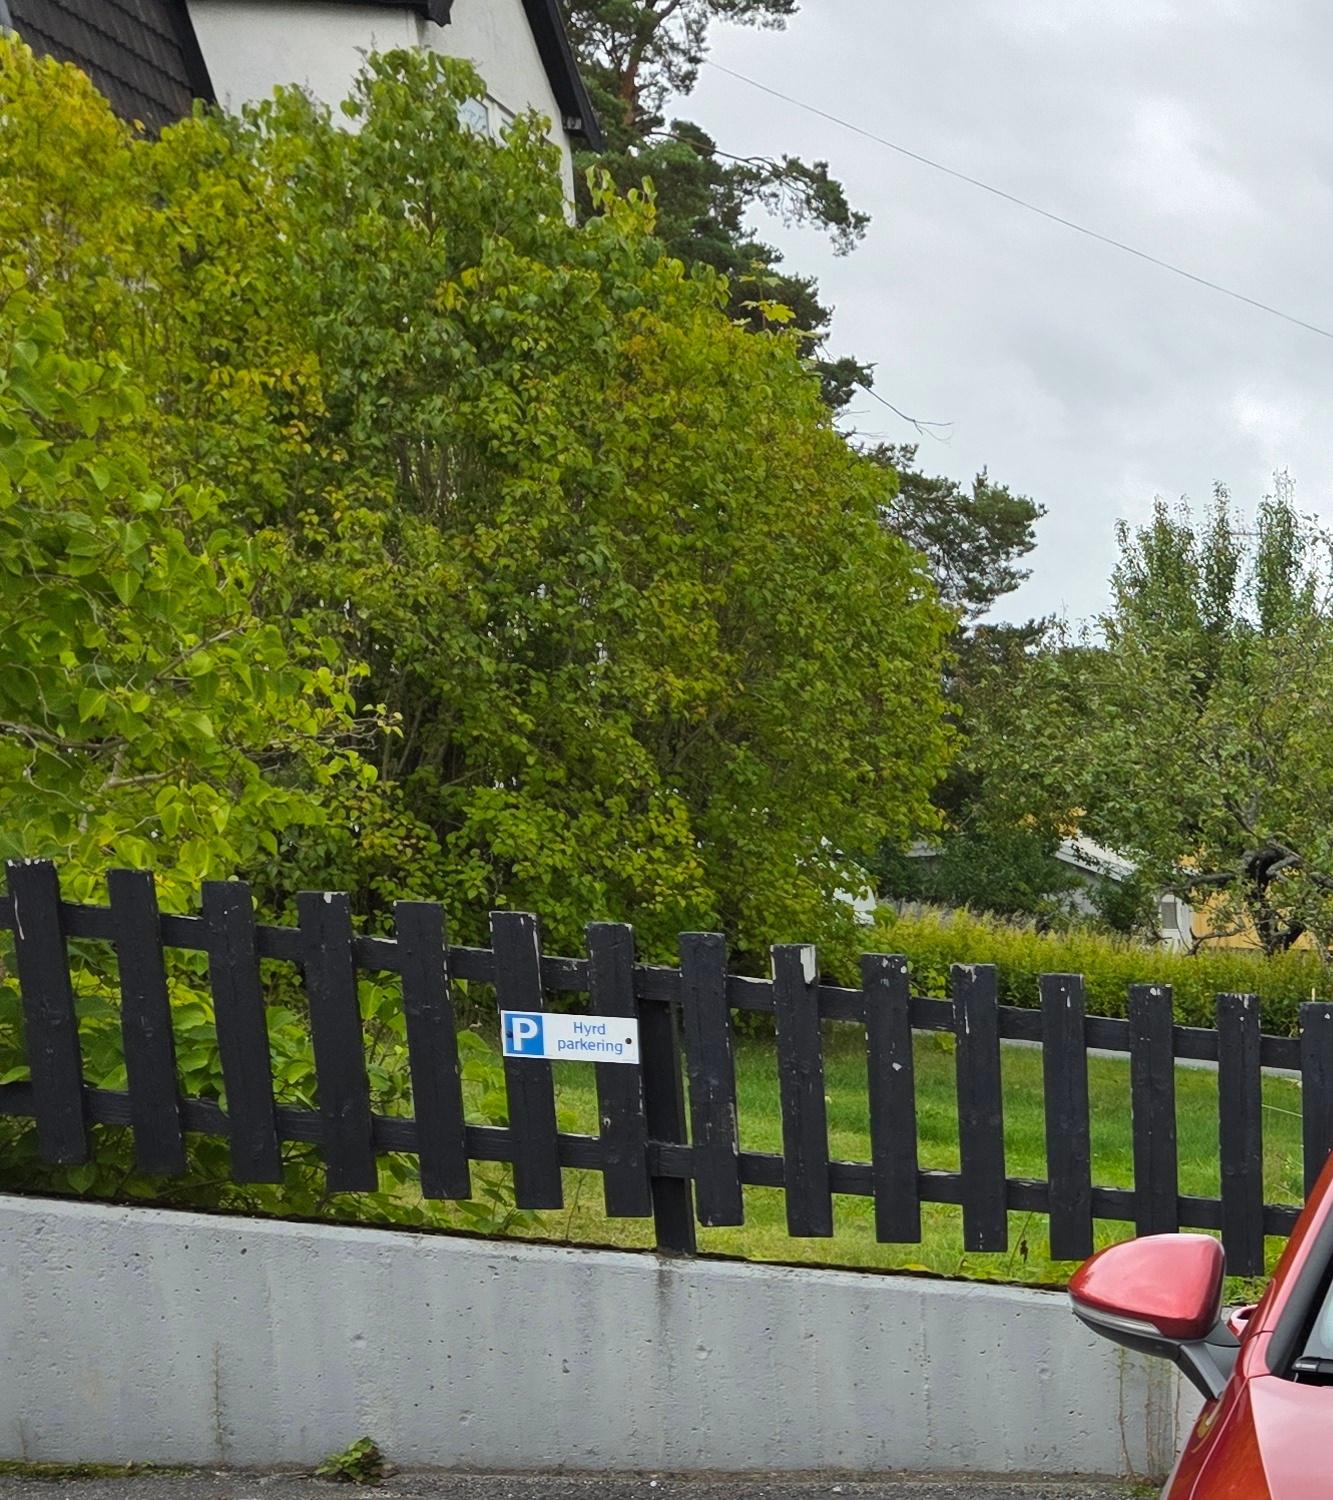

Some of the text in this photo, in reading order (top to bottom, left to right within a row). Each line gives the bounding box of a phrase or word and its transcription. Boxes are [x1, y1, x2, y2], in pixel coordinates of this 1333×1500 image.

[512, 1017, 538, 1051] P
[573, 1021, 606, 1037] Hyrd
[557, 1038, 623, 1054] parkering
